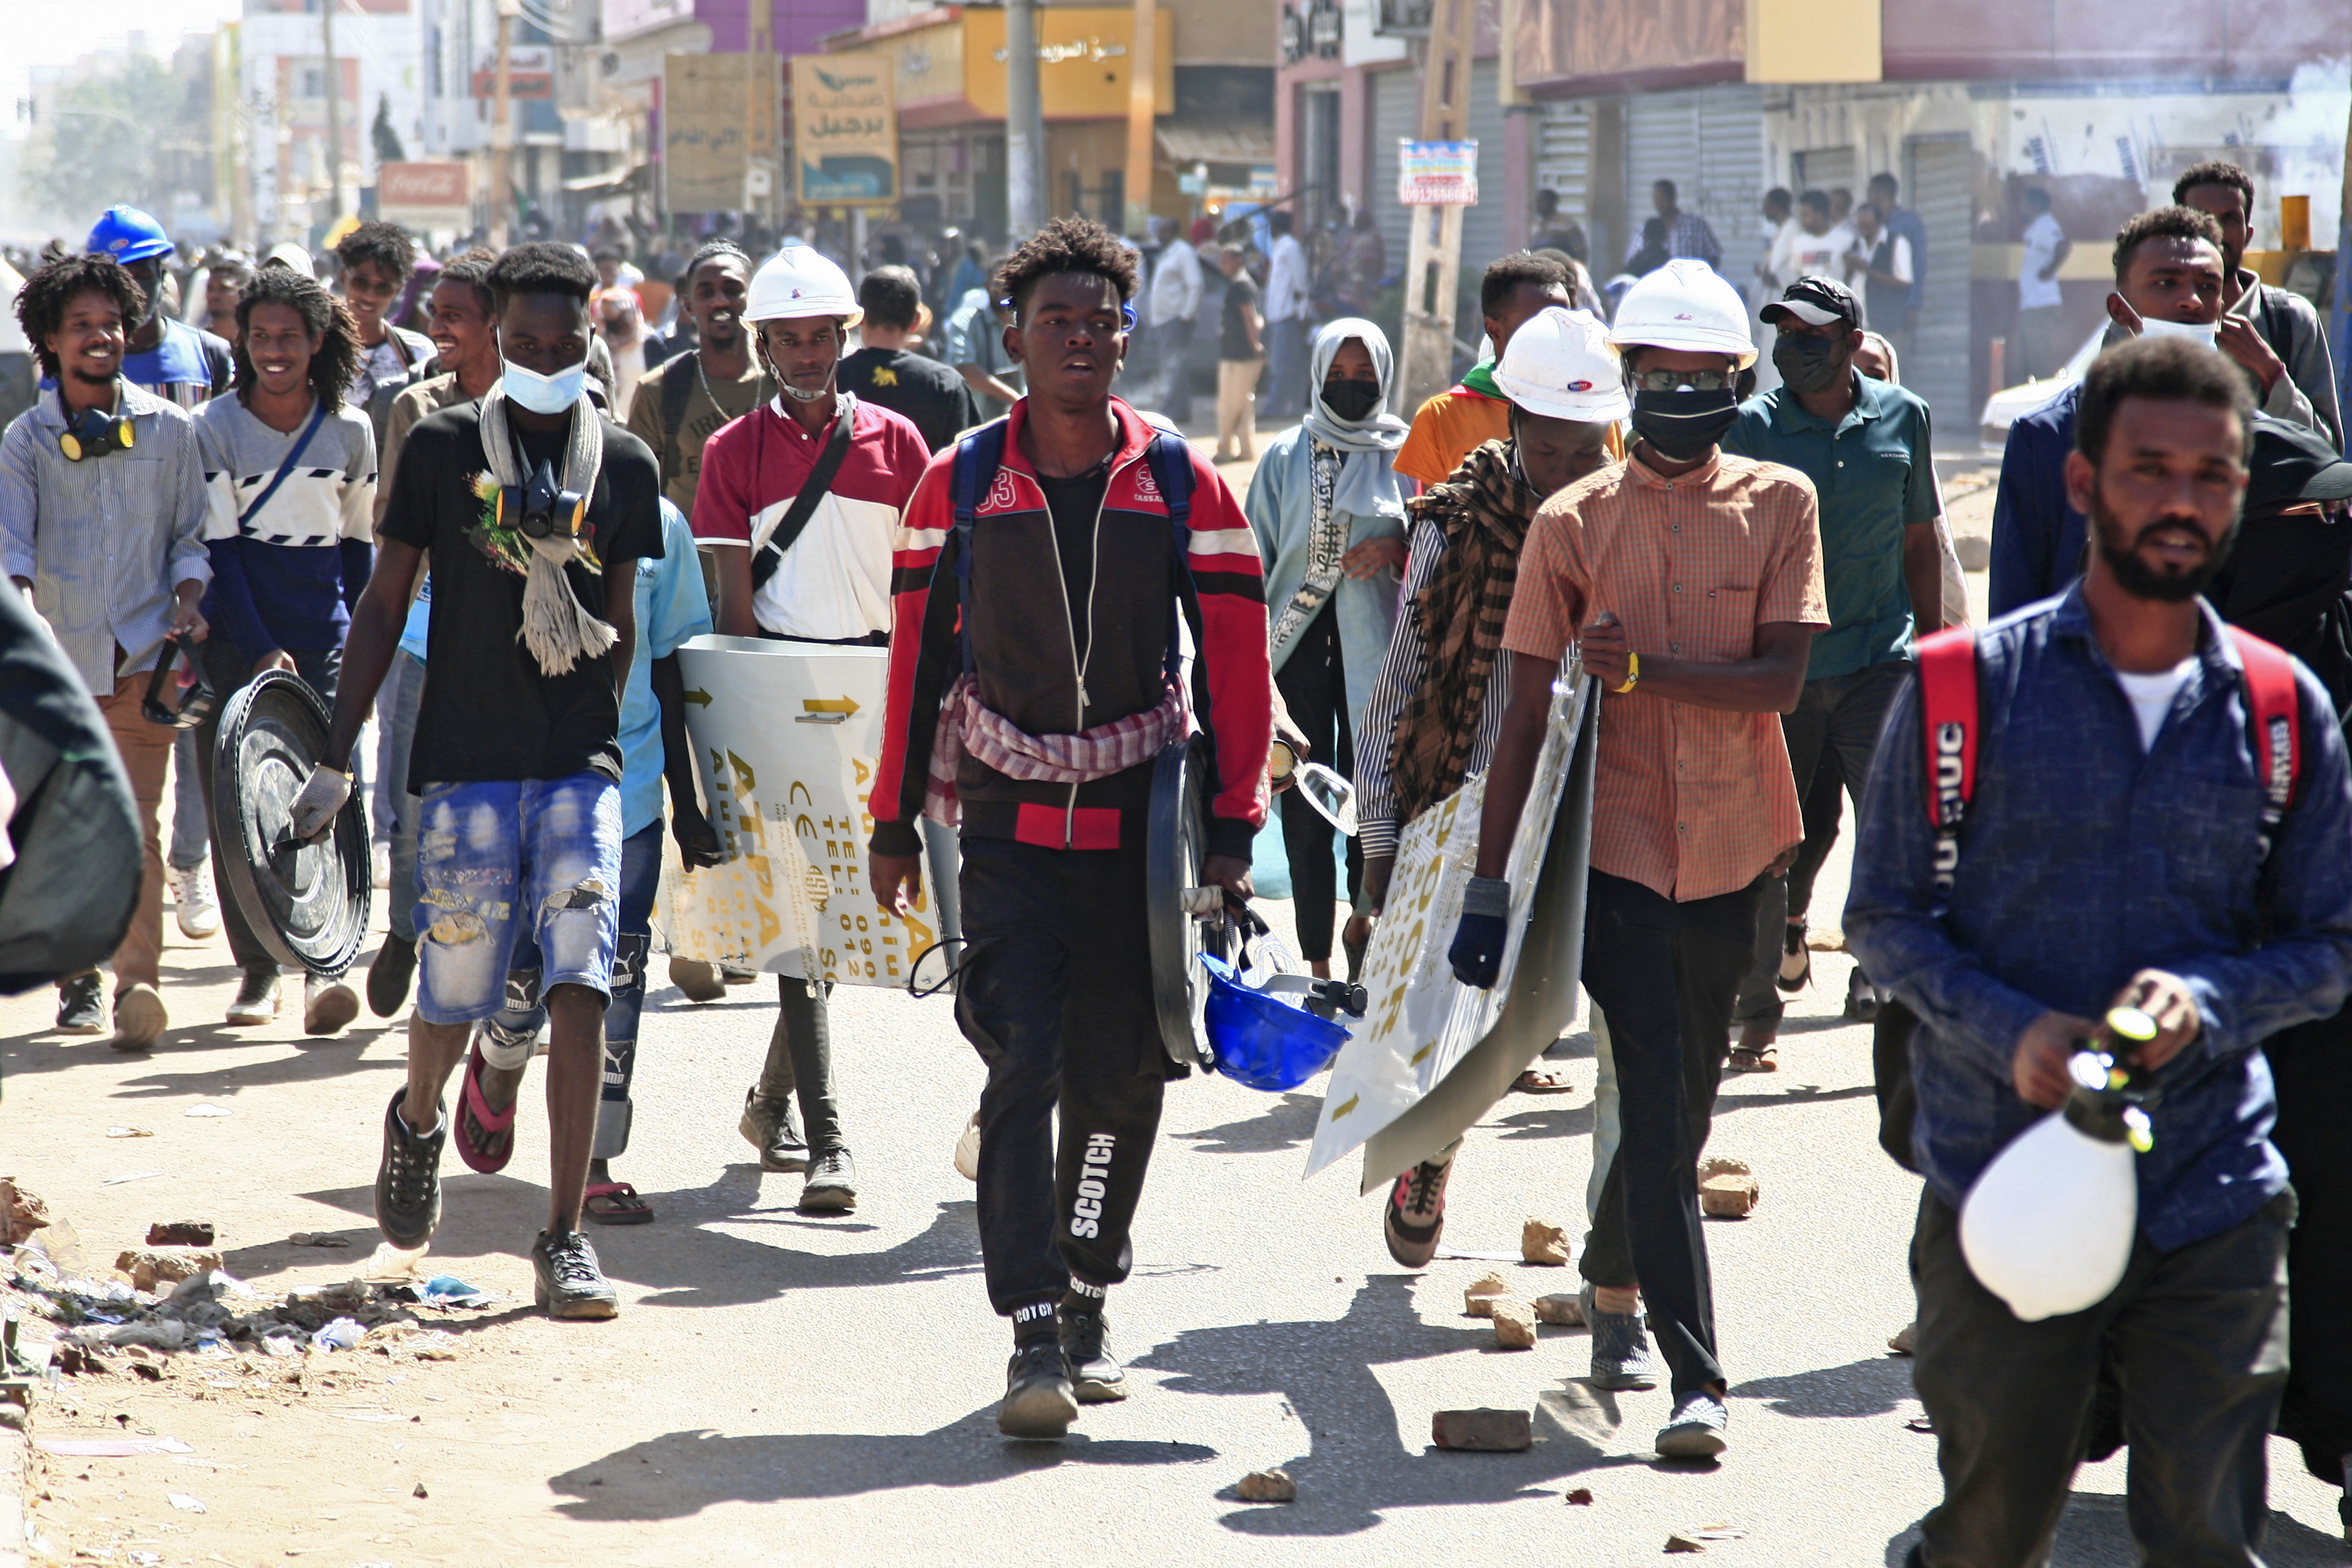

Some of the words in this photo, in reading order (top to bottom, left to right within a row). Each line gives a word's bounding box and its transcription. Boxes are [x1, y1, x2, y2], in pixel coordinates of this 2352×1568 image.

[727, 748, 782, 949] ATPA
[823, 814, 843, 895] TEL:
[840, 913, 860, 976] 012
[839, 815, 860, 896] TEL:
[856, 915, 876, 978] 090
[610, 973, 633, 987] UMA
[1071, 1134, 1116, 1238] SCOTCH
[1014, 1302, 1053, 1324] COTCH
[1070, 1276, 1108, 1299] COTCH
